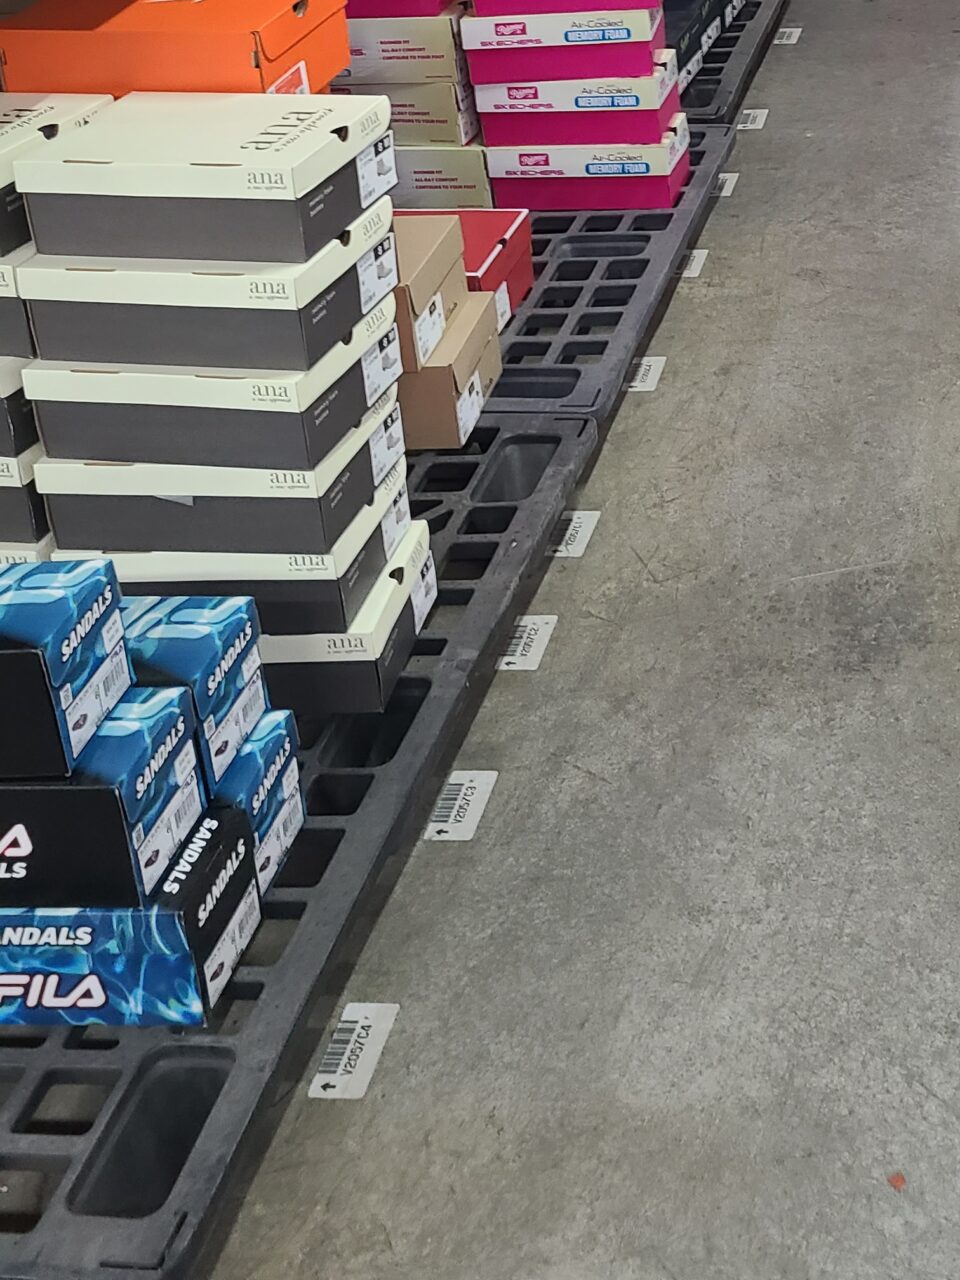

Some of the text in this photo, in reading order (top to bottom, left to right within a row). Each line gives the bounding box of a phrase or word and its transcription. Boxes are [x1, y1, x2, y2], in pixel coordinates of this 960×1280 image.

[571, 19, 624, 29] Air-Cooled
[566, 28, 629, 42] MEMORY FOAM
[581, 86, 633, 95] Air-Cooled
[576, 95, 638, 108] MEMORY FOAM
[592, 153, 643, 162] Air-Cooled
[588, 163, 648, 175] MEMORY FOAM
[247, 170, 285, 186] ana
[249, 280, 287, 295] ana
[252, 383, 289, 398] ana
[269, 471, 308, 485] ana
[288, 554, 327, 568] ana
[61, 584, 113, 663] SANDALS
[326, 636, 365, 650] ana
[207, 621, 253, 696] SANDALS
[136, 715, 186, 800] SANDALS
[252, 736, 292, 816] SANDALS
[452, 785, 477, 825] V2057C3
[162, 817, 220, 896] SANDALS
[197, 838, 246, 928] SANDALS
[0, 927, 93, 946] NDALS
[0, 974, 107, 1009] FILA
[341, 1024, 373, 1078] V2057C4
